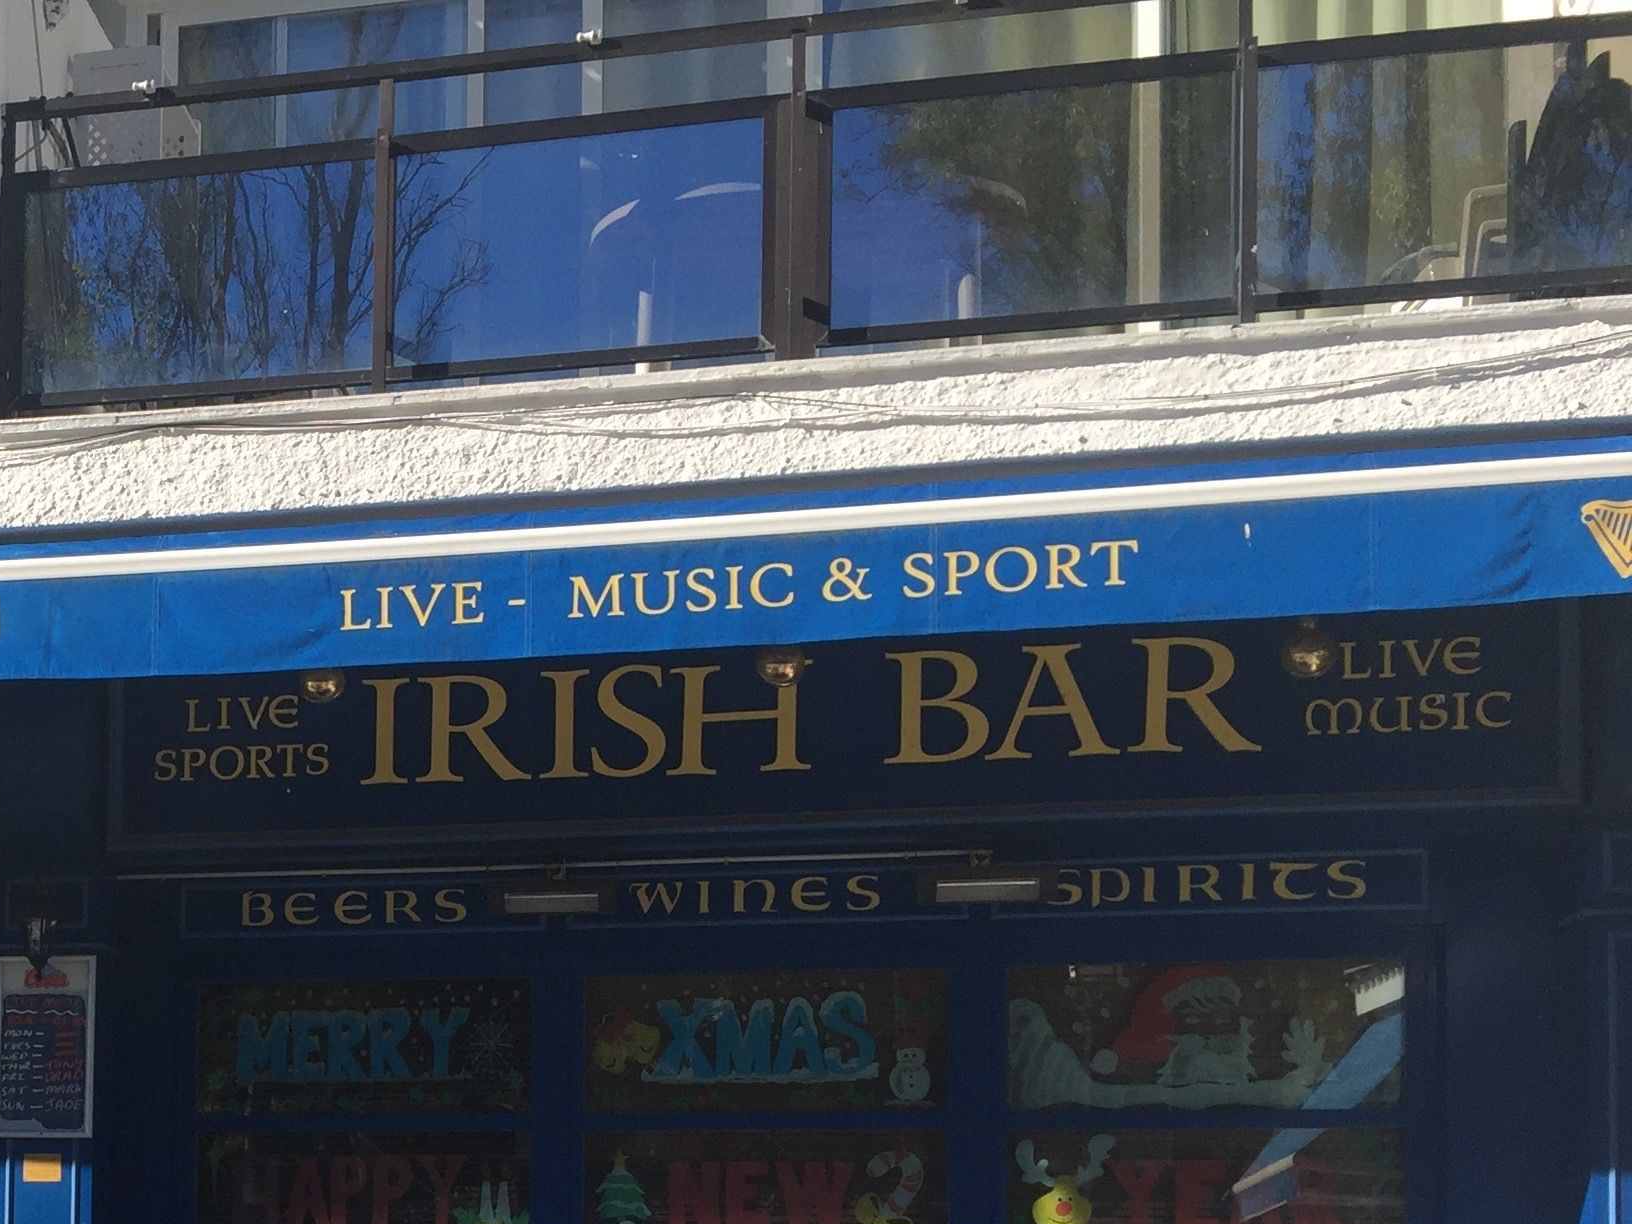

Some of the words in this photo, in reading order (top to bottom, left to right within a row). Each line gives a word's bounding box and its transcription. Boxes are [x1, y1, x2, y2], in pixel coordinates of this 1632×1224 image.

[340, 580, 485, 631] LIVE
[568, 562, 795, 618] MUSIC
[822, 555, 873, 602] &
[903, 539, 1139, 598] SPORT
[1340, 635, 1483, 682] LIVE
[186, 695, 299, 734] LIVE
[359, 664, 813, 786] IRISH
[883, 635, 1263, 767] BAR
[154, 742, 330, 783] SPORTS
[241, 886, 468, 928] BEERS
[634, 877, 882, 915] WINES
[1046, 858, 1368, 908] SPIRITS
[235, 1007, 471, 1081] MERRY
[654, 991, 879, 1080] XMAS
